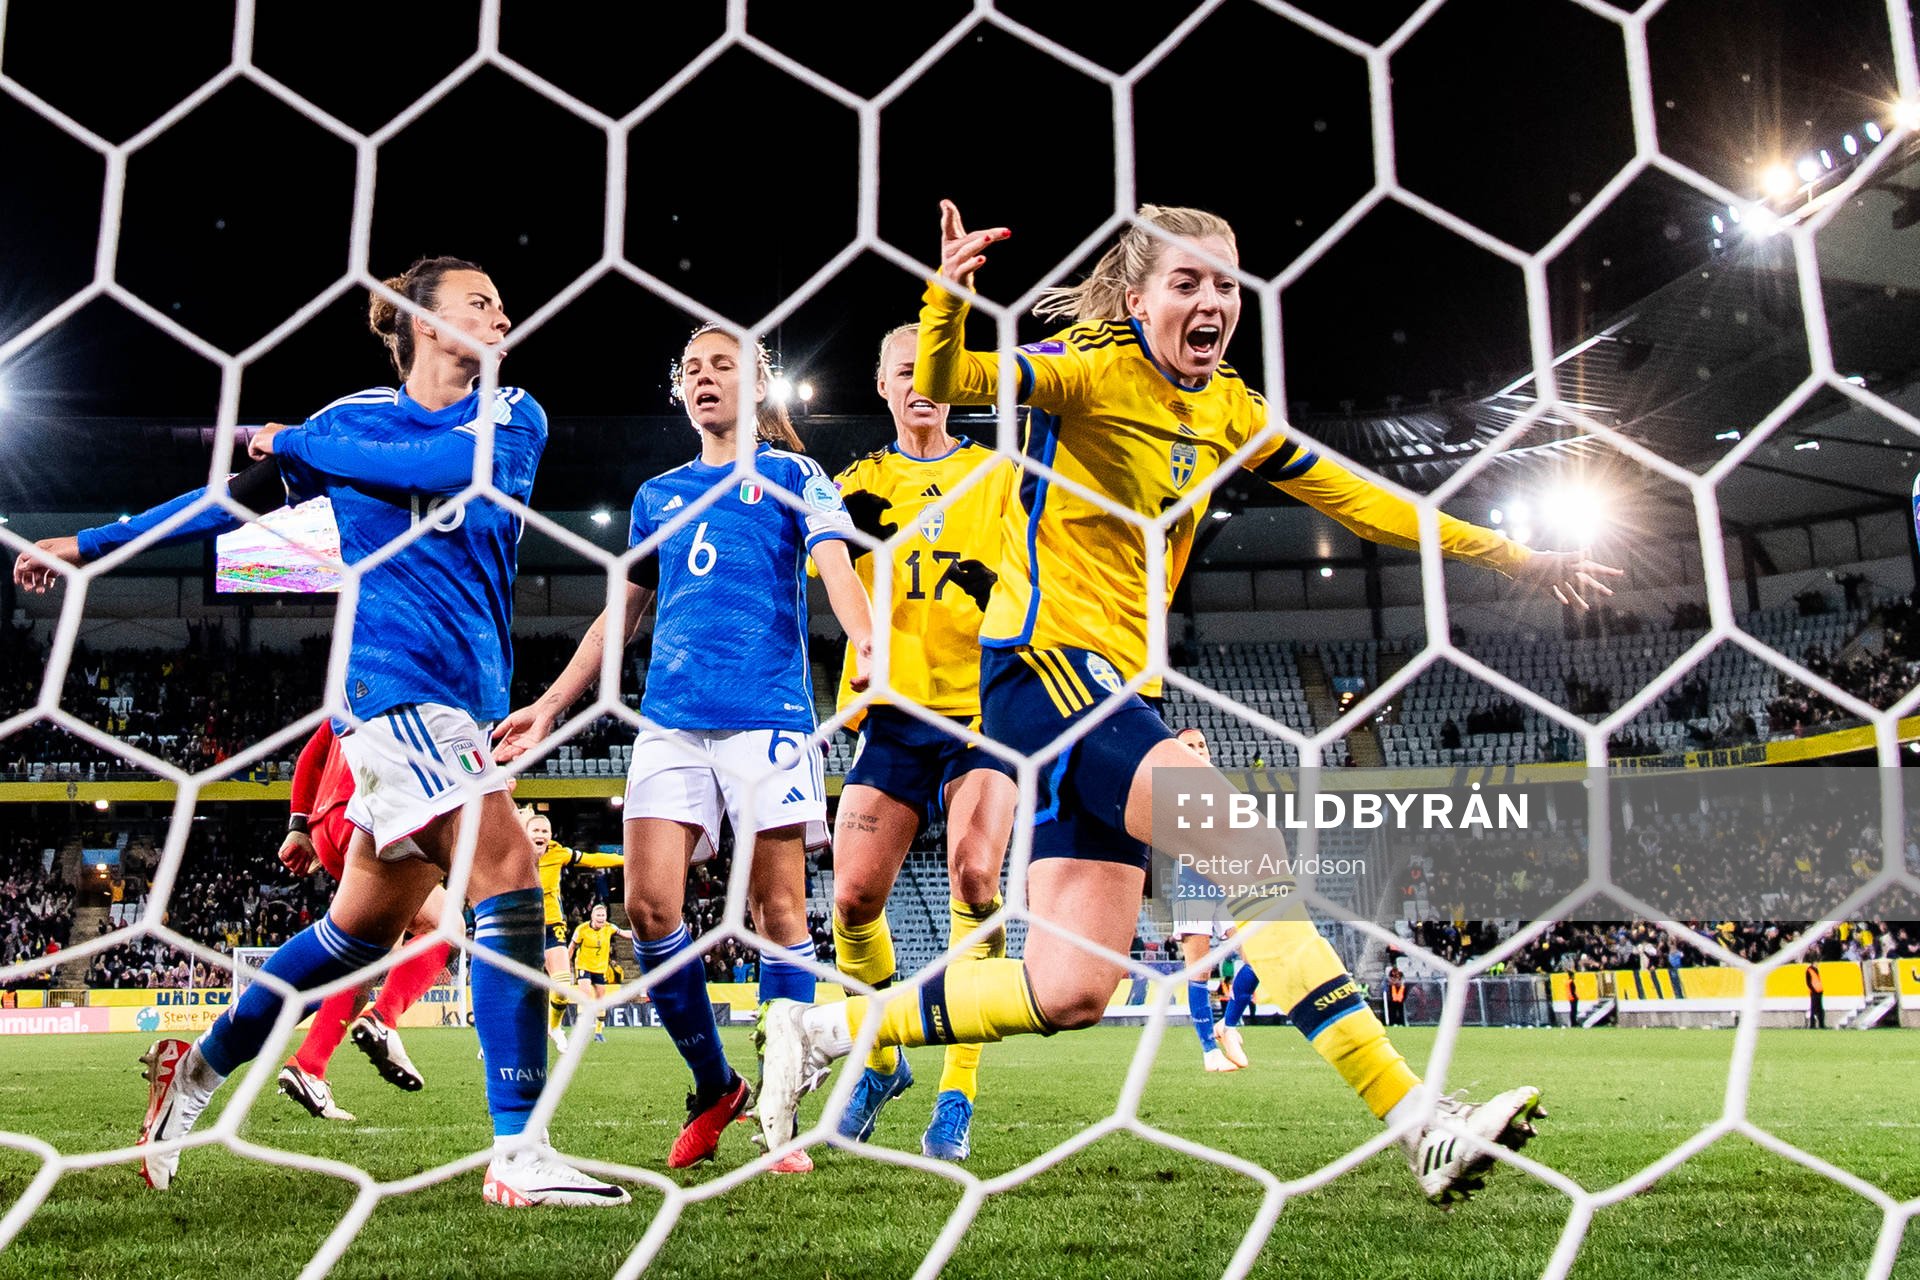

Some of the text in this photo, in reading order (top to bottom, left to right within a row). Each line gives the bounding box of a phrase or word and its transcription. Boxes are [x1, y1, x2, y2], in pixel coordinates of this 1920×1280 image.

[687, 521, 718, 577] 6
[905, 549, 962, 601] 17
[768, 729, 801, 771] 6
